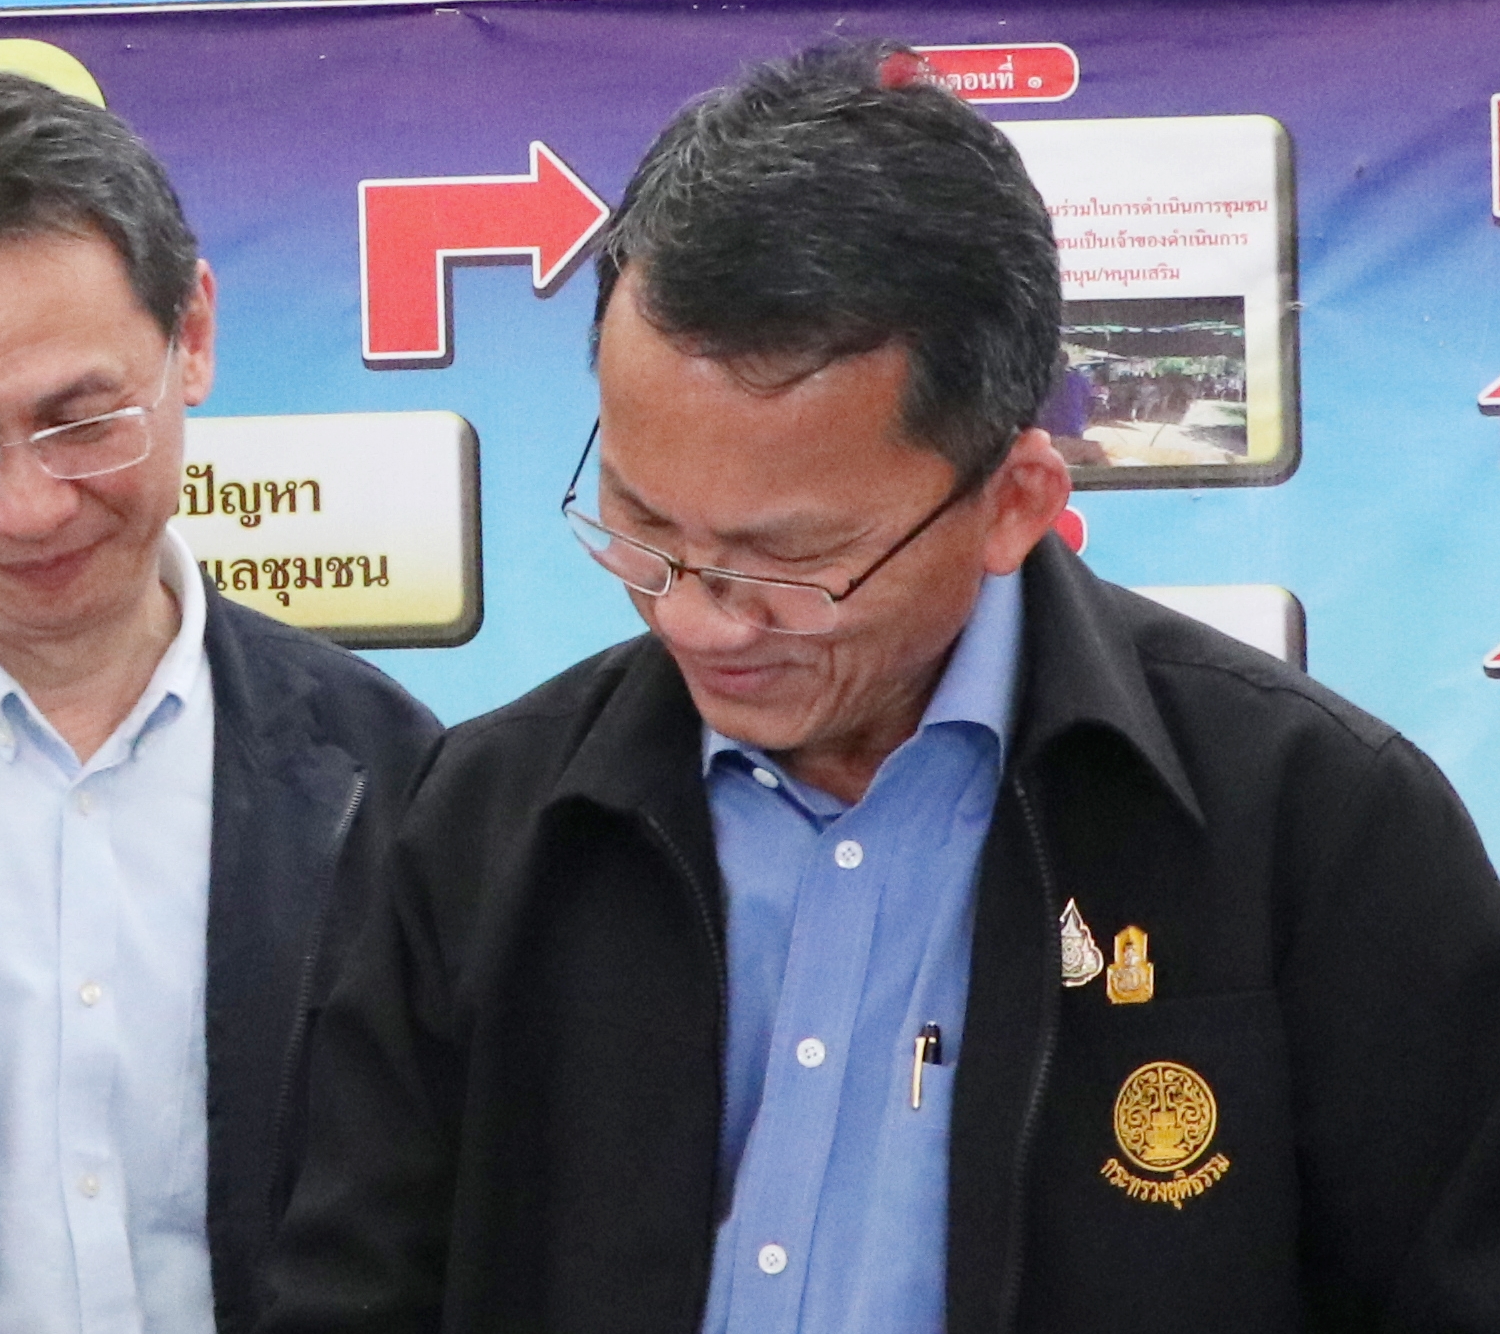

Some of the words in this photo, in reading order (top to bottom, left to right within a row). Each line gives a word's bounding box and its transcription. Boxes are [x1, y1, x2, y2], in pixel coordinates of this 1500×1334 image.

[1047, 196, 1269, 218] นร่วมในการดำเนินการชุมชน
[1056, 230, 1249, 251] ชนเป็นเจ้าของดำเนินการ
[1060, 263, 1181, 287] สนุน/หนุนเสริม
[183, 464, 322, 529] ปัญหา
[203, 553, 390, 607] แลชุมชน
[1100, 1152, 1231, 1210] กระทรวงยุติธรรม
